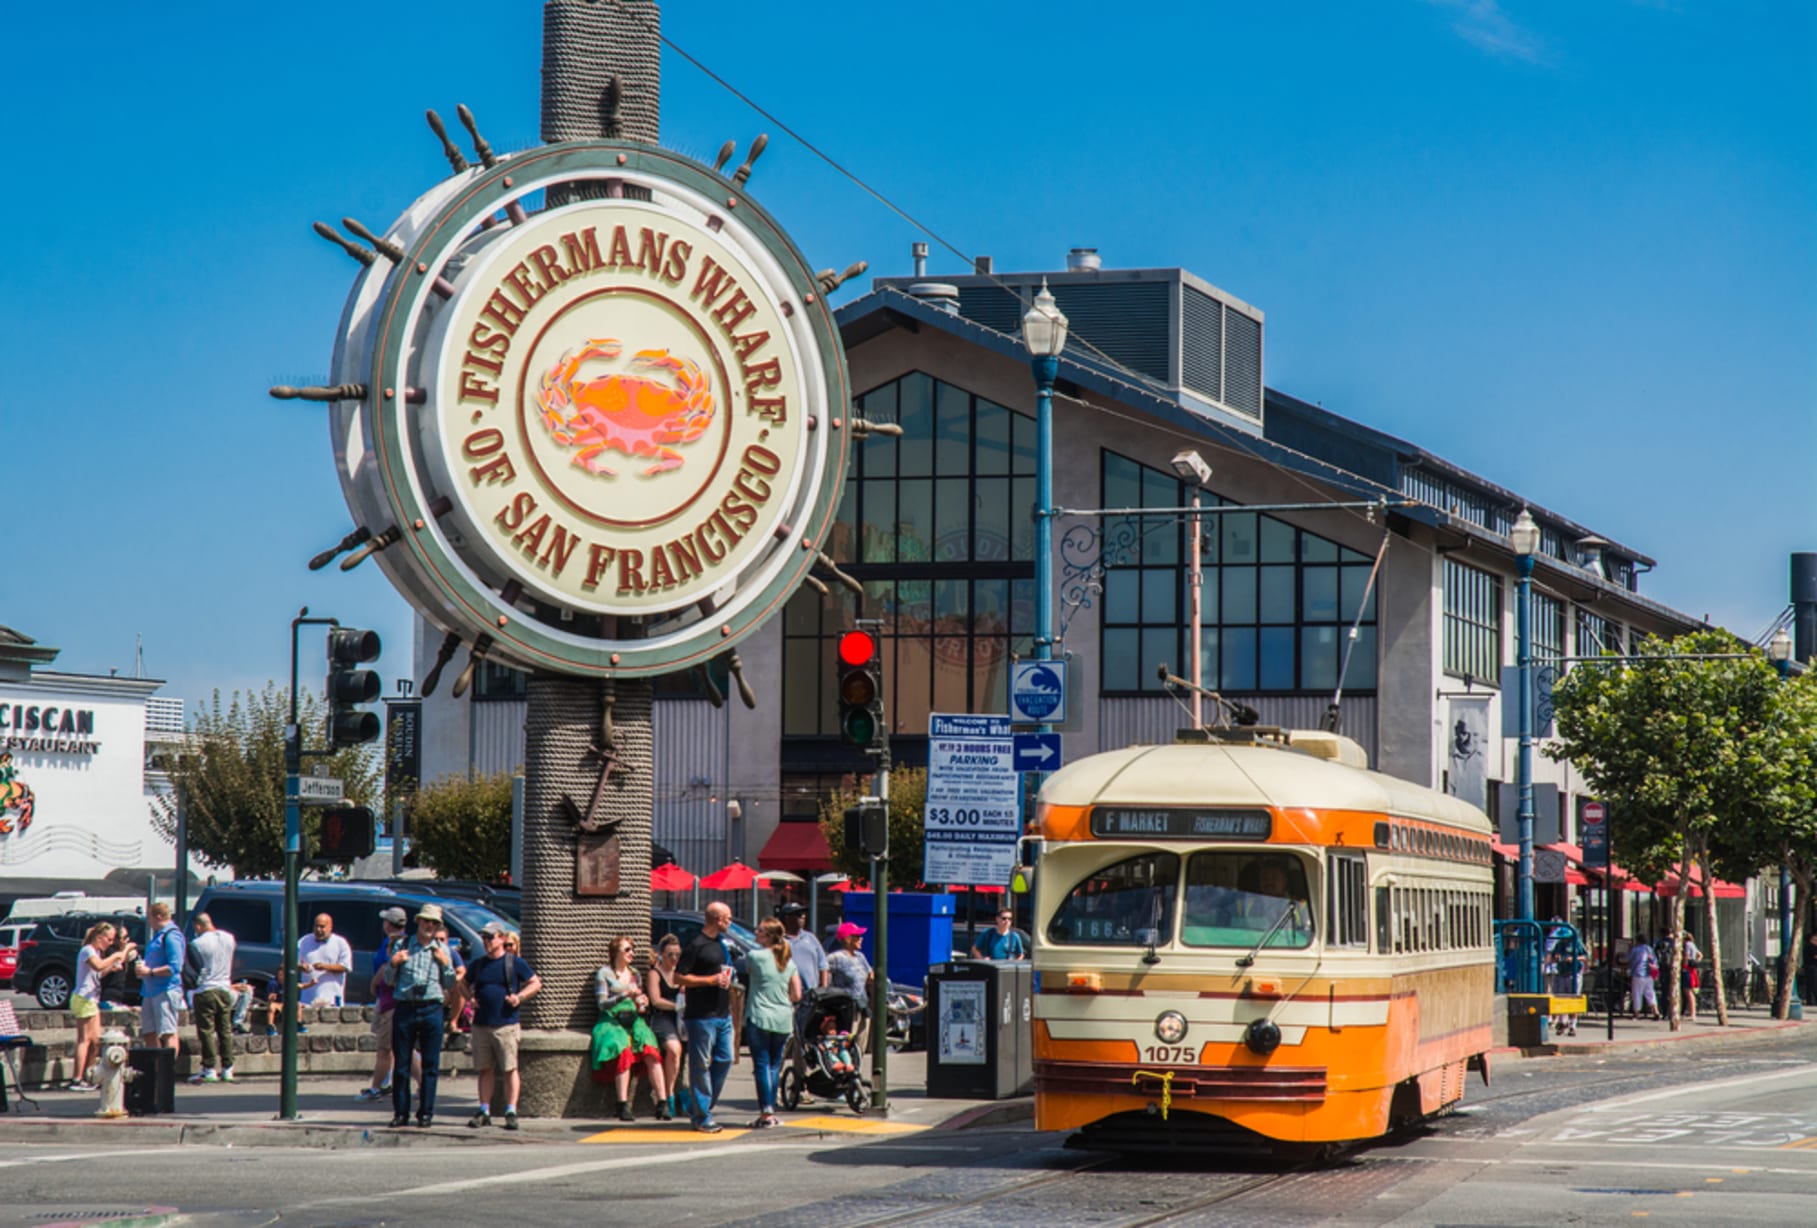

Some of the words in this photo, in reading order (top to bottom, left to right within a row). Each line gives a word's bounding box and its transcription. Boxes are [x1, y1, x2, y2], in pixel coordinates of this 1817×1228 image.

[458, 225, 693, 404] FISHERMANS
[690, 255, 787, 425] WHARF
[462, 428, 517, 487] OF
[497, 492, 581, 576] SAN
[584, 444, 782, 593] FRANCISCO
[0, 703, 93, 733] CISCAN
[950, 755, 999, 765] PARKING
[302, 780, 340, 795] Jefferson
[930, 808, 980, 825] $3.00
[1106, 812, 1114, 831] F
[1119, 812, 1169, 831] MARKET
[1145, 1046, 1195, 1063] 1075
